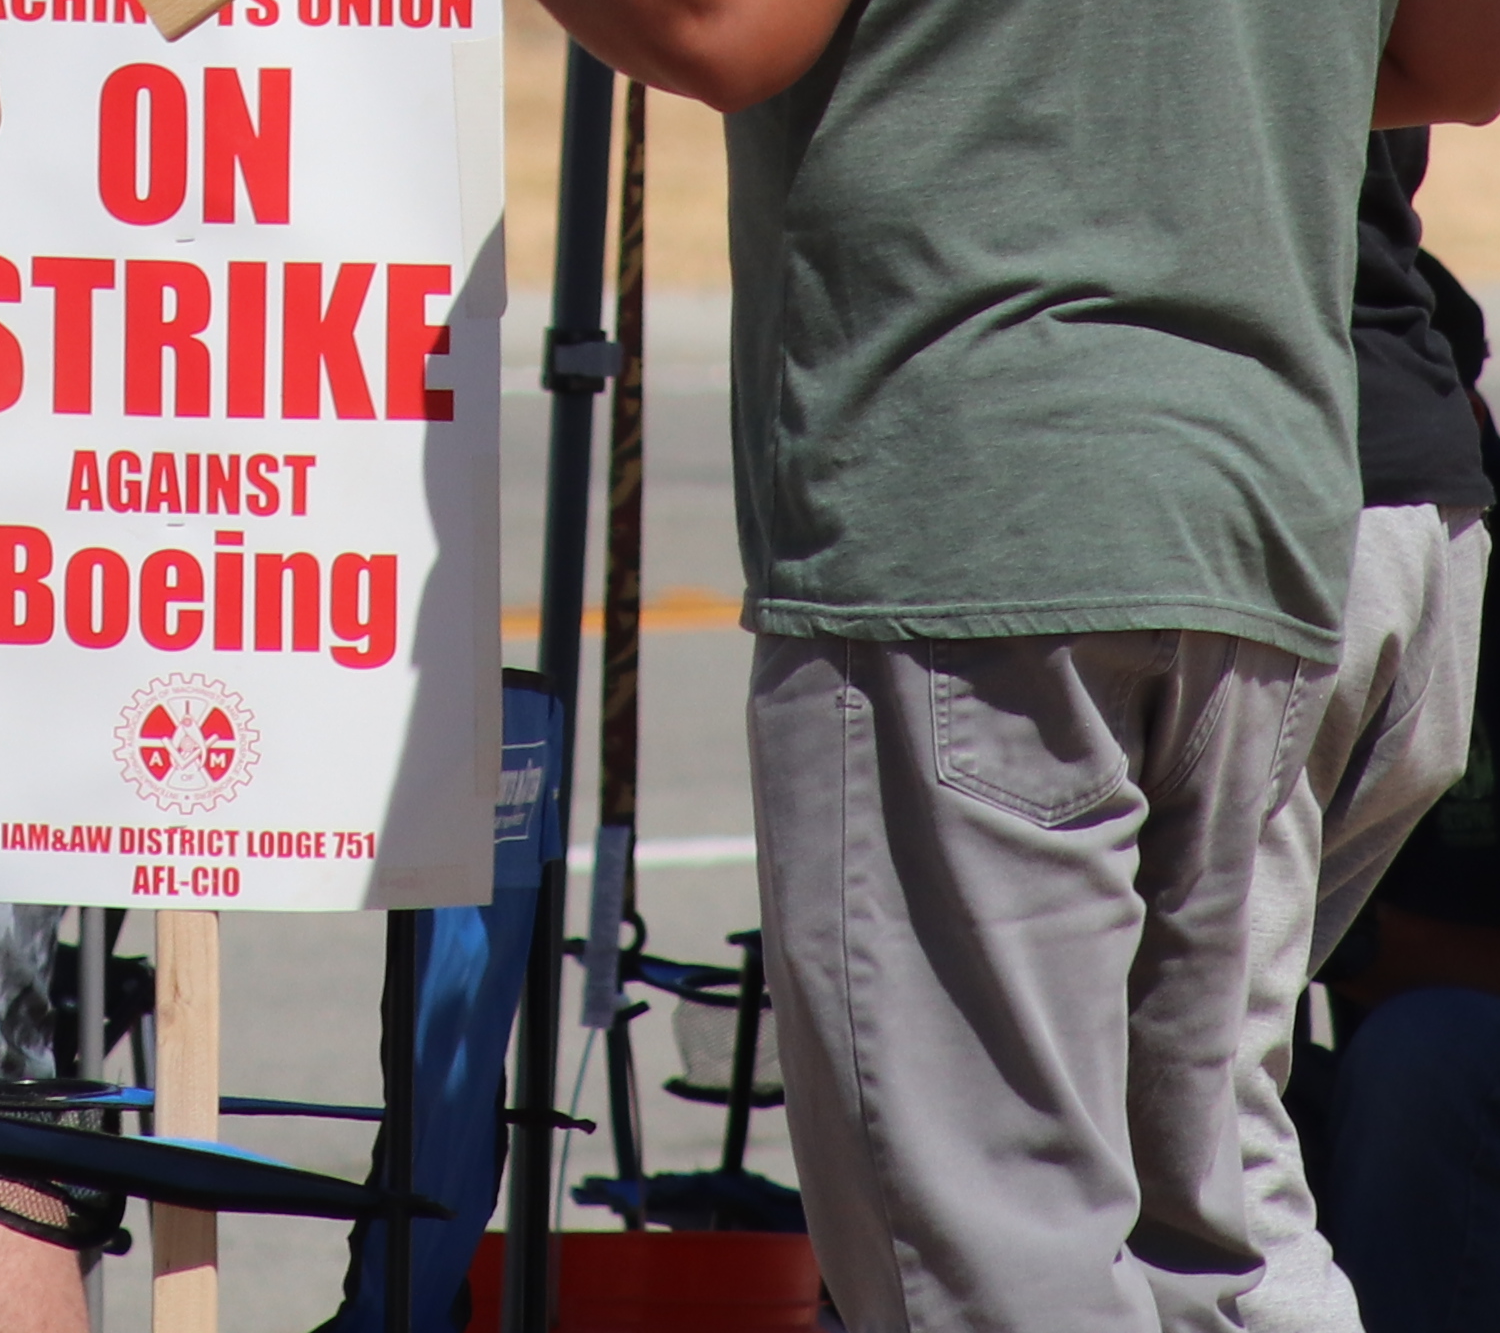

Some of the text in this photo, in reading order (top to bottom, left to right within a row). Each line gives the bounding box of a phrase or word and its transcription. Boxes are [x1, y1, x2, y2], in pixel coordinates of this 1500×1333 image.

[98, 63, 292, 226] ON
[67, 450, 317, 516] AGAINST
[1, 823, 375, 859] IAM&AW DISTRICT LODGE 751
[132, 865, 240, 897] AFL-CIO
